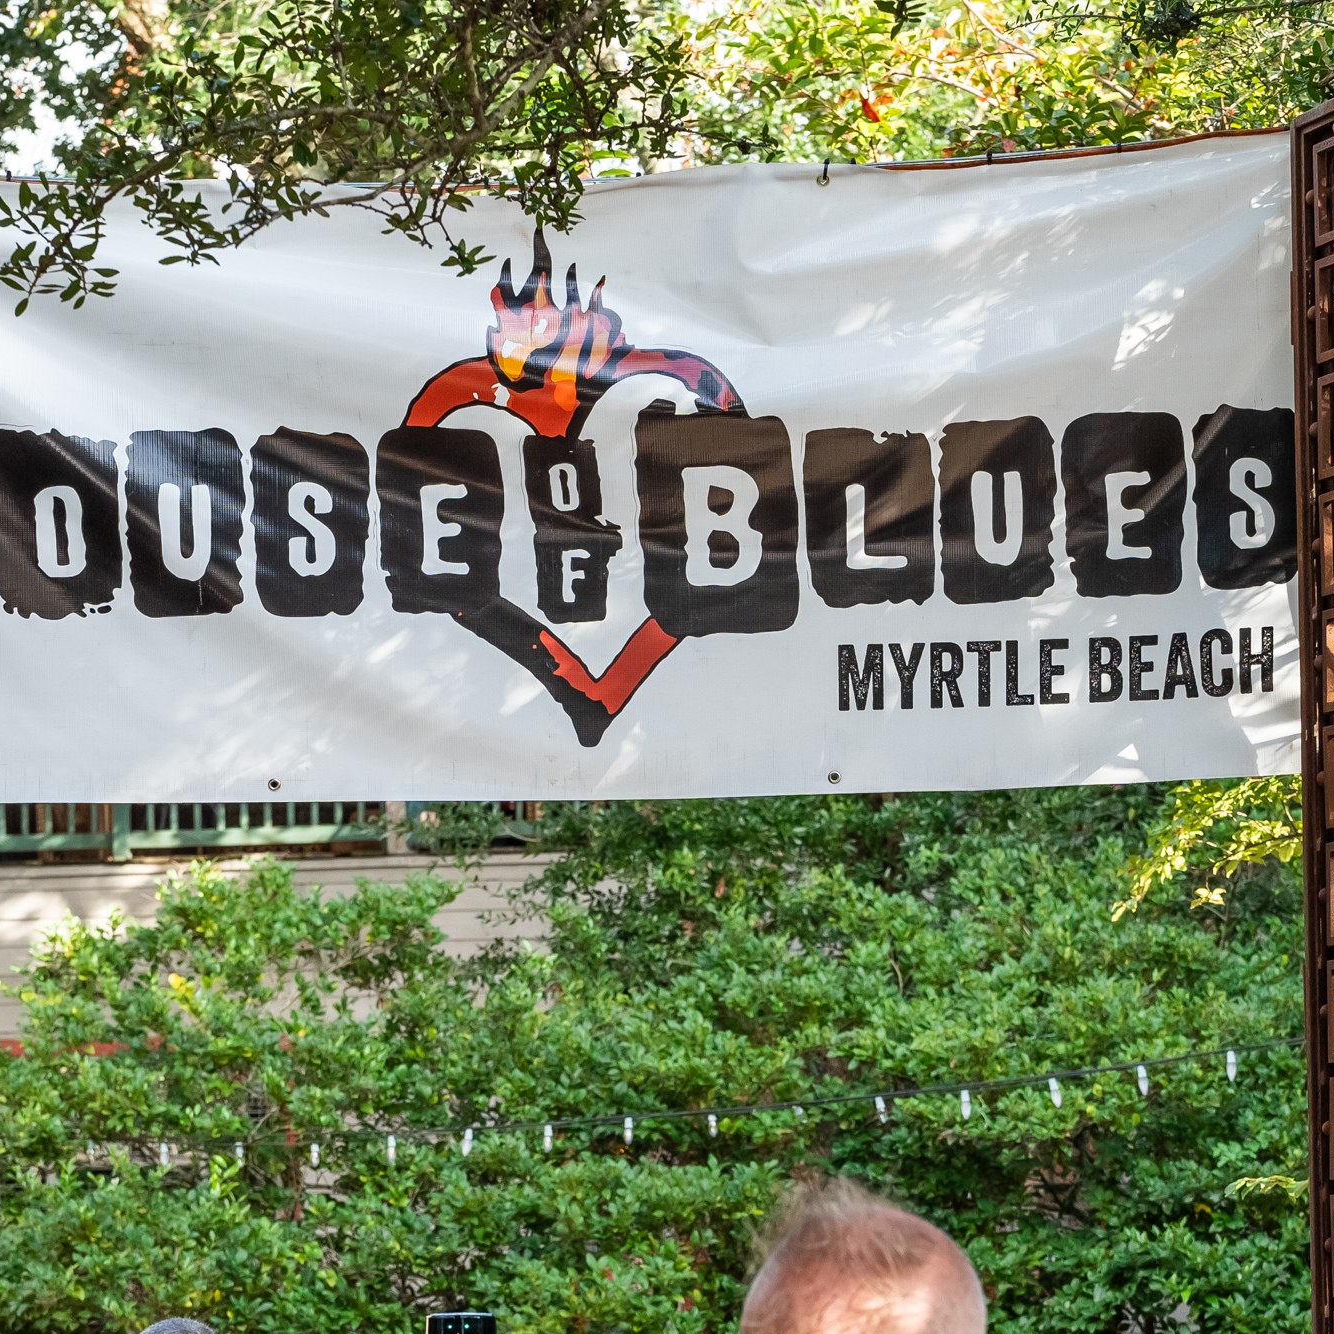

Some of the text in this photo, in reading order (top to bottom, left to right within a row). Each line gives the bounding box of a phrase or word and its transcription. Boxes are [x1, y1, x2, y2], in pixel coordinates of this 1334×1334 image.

[548, 460, 591, 605] OF
[679, 455, 1278, 589] BLUES
[836, 625, 1275, 712] MYRTLE BEACH
